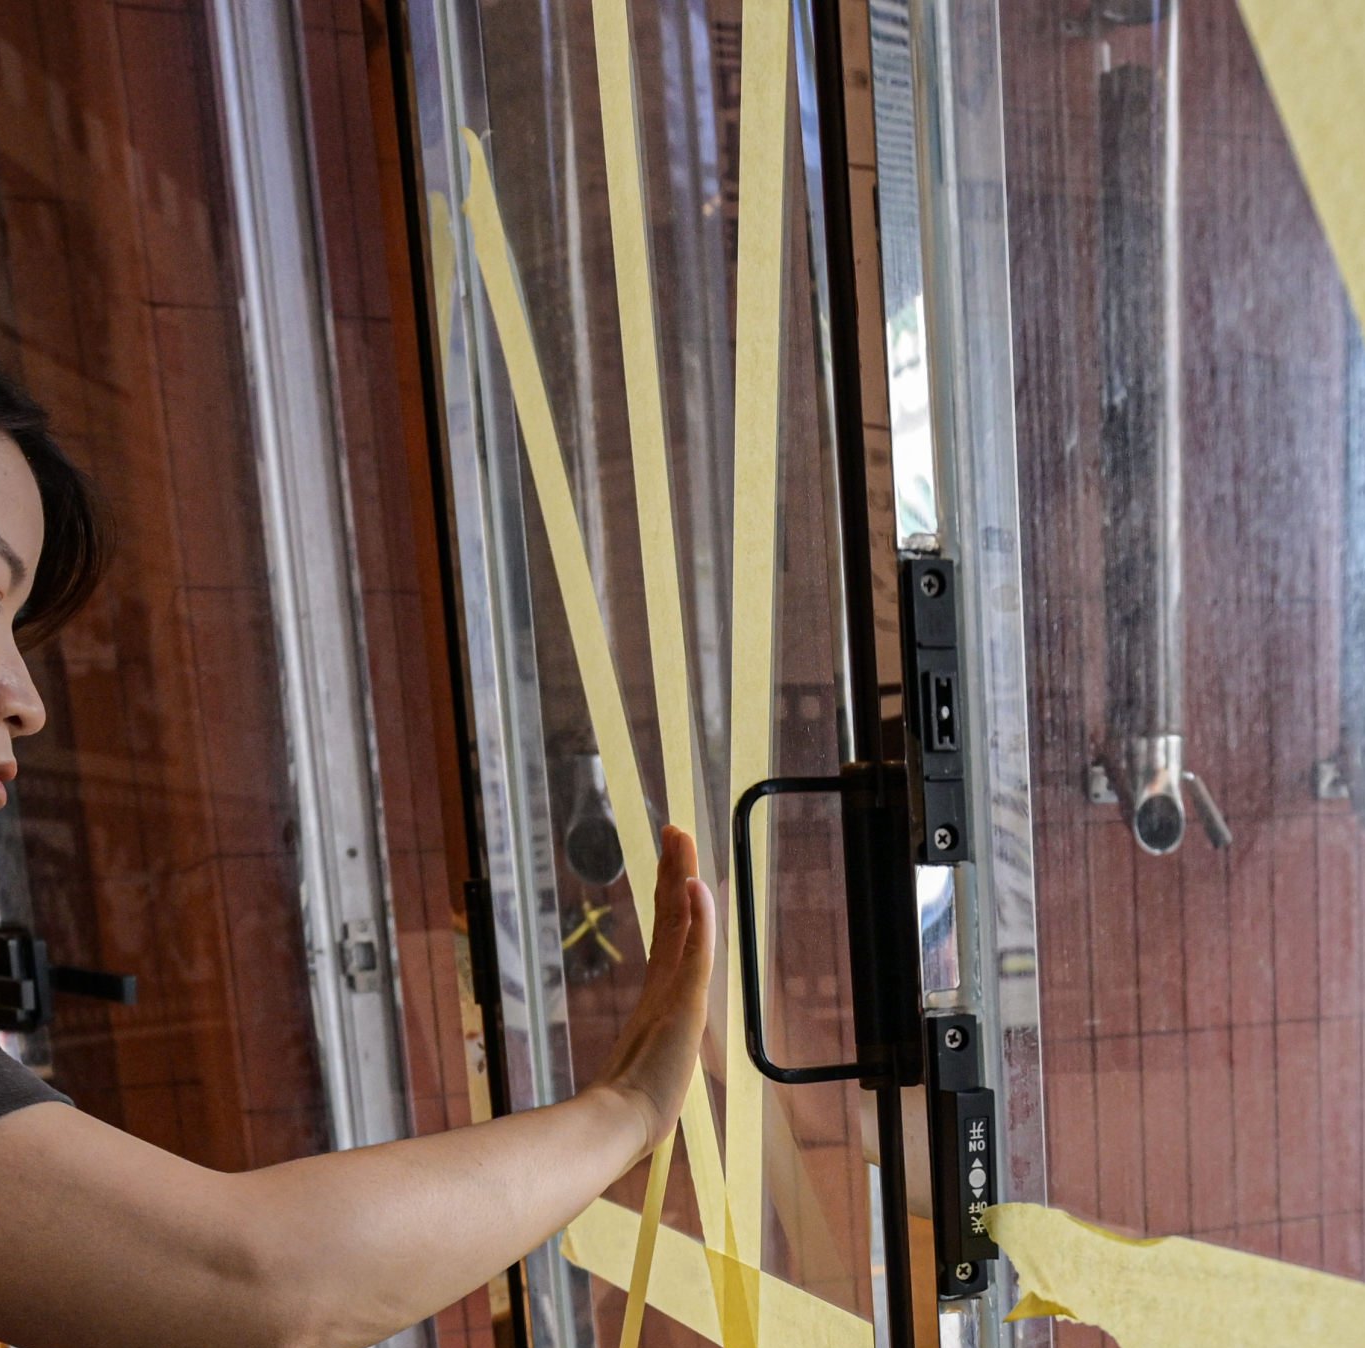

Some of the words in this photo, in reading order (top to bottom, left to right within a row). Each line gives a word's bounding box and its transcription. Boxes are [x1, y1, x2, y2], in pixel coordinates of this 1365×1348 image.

[969, 1121, 985, 1140] 开
[968, 1140, 986, 1153] ON
[968, 1201, 988, 1214] OFF
[971, 1216, 986, 1234] 关
